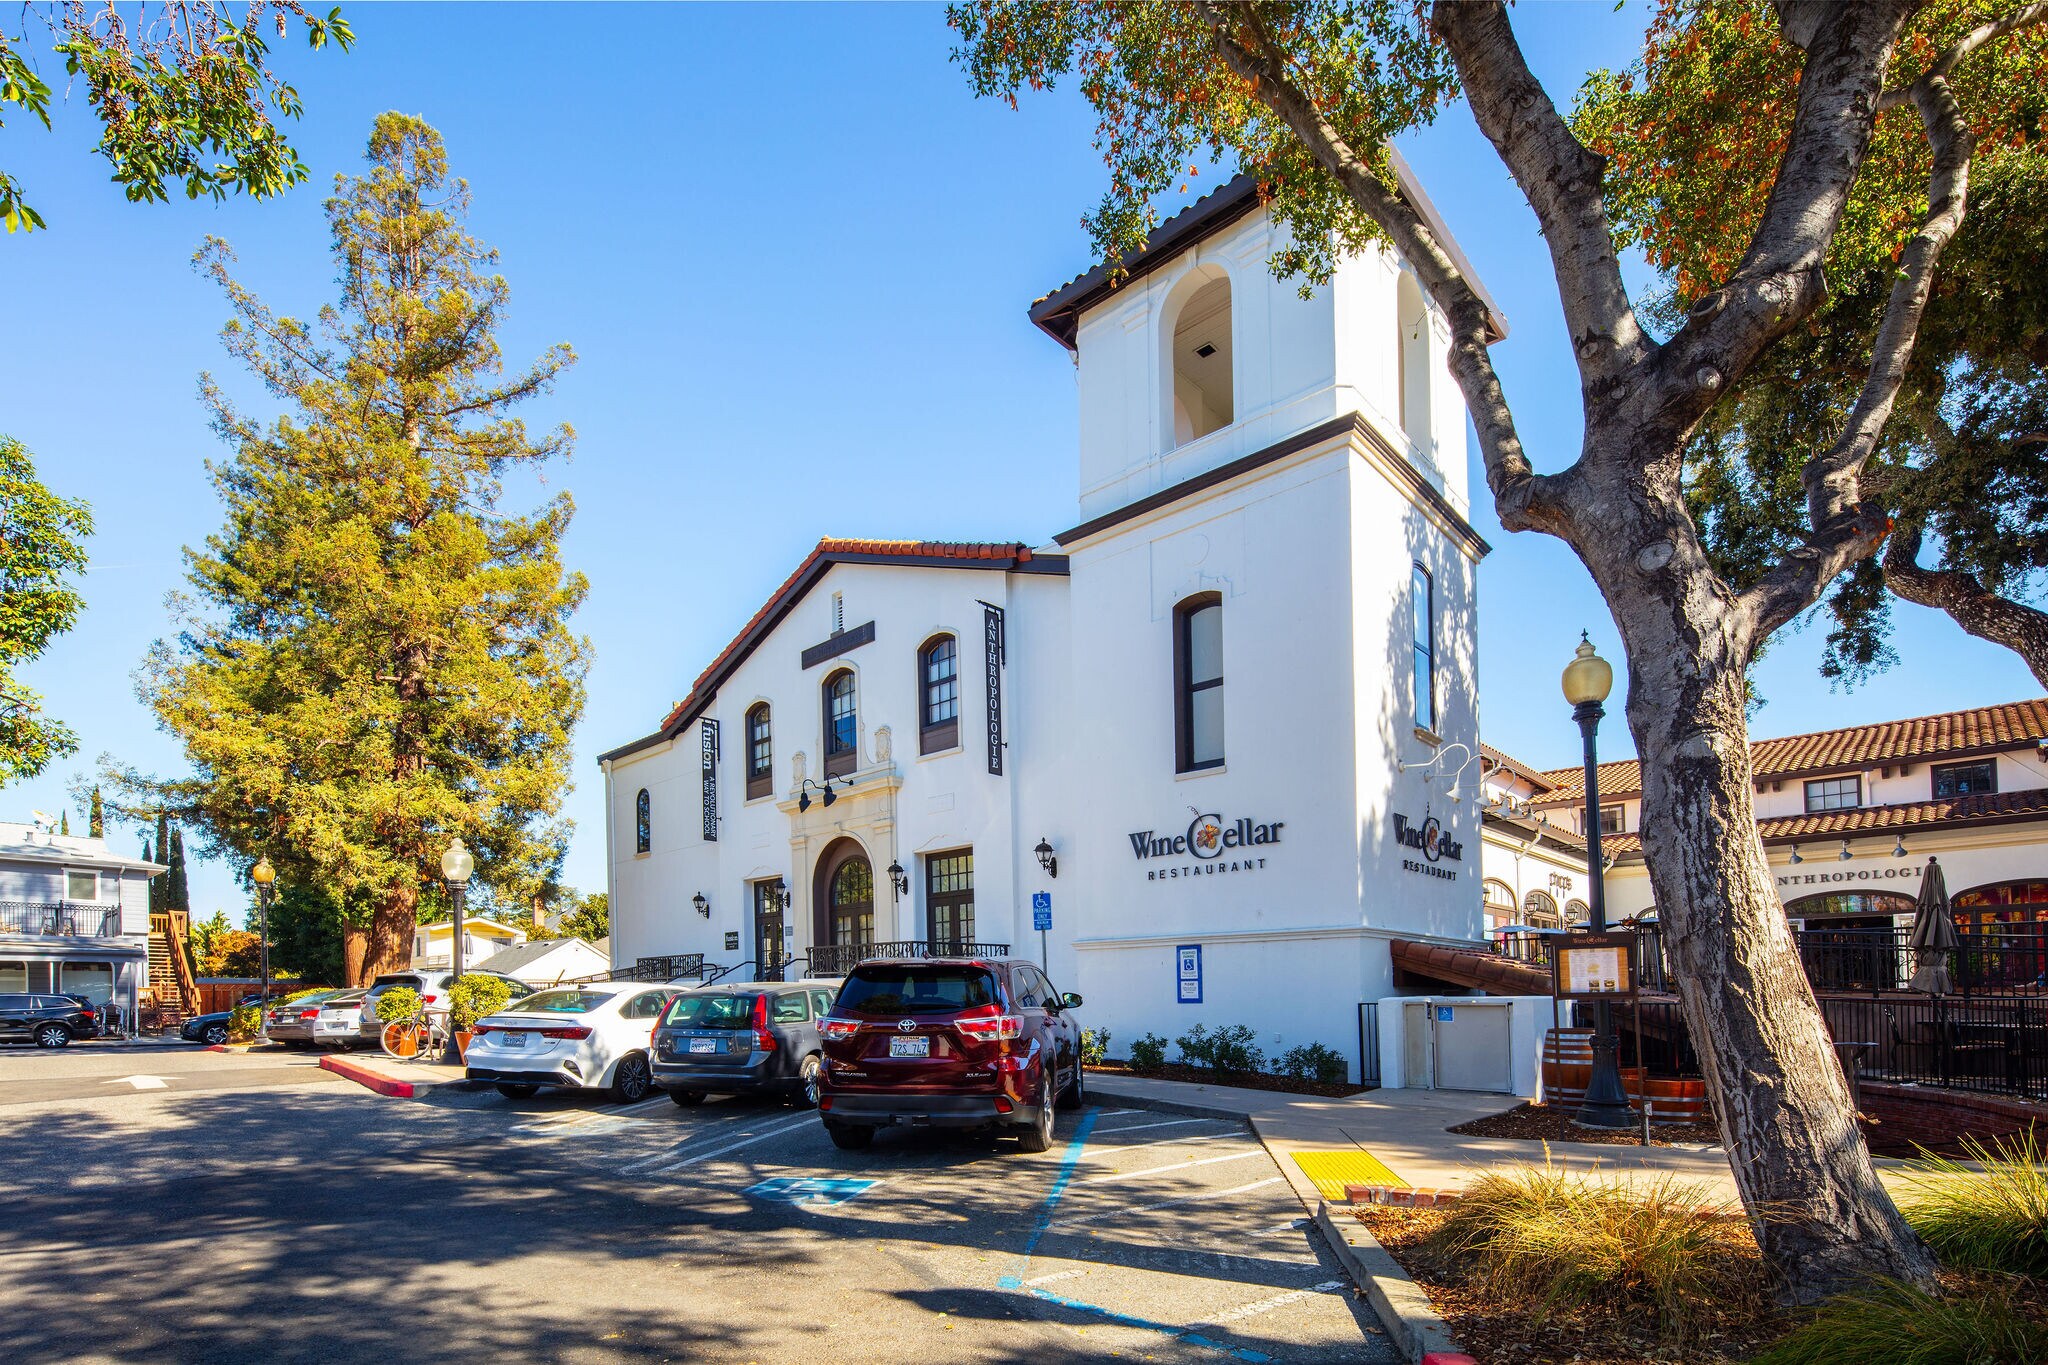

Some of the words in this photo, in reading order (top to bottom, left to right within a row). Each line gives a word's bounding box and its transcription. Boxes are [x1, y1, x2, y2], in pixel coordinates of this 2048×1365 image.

[988, 618, 999, 769] ANTHROPOLOGIE
[702, 725, 715, 770] fusion
[704, 795, 709, 806] TO
[1148, 858, 1266, 881] RESTAURANT
[1403, 859, 1457, 881] RESTAURANT
[1777, 866, 1922, 886] NTHROPOLOGI
